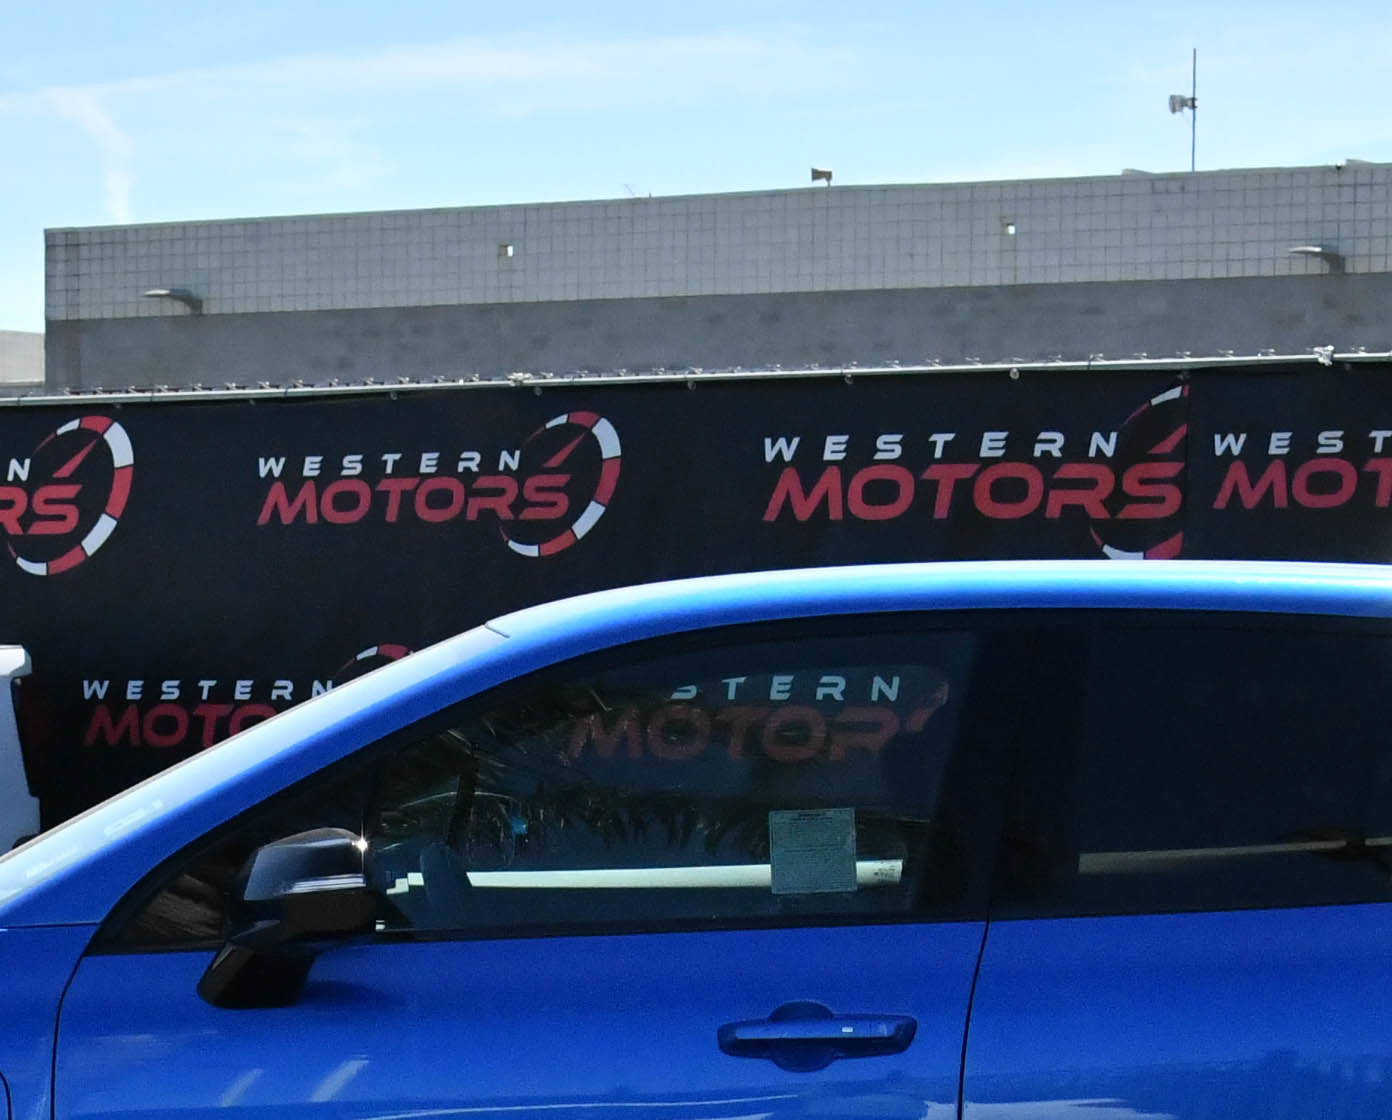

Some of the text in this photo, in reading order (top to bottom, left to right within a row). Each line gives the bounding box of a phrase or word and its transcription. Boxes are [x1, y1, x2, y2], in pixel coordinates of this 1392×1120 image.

[258, 450, 521, 478] WESTERN
[763, 431, 1118, 462] WESTERN
[258, 475, 571, 525] MOTORS
[762, 462, 1185, 522] MOTORS
